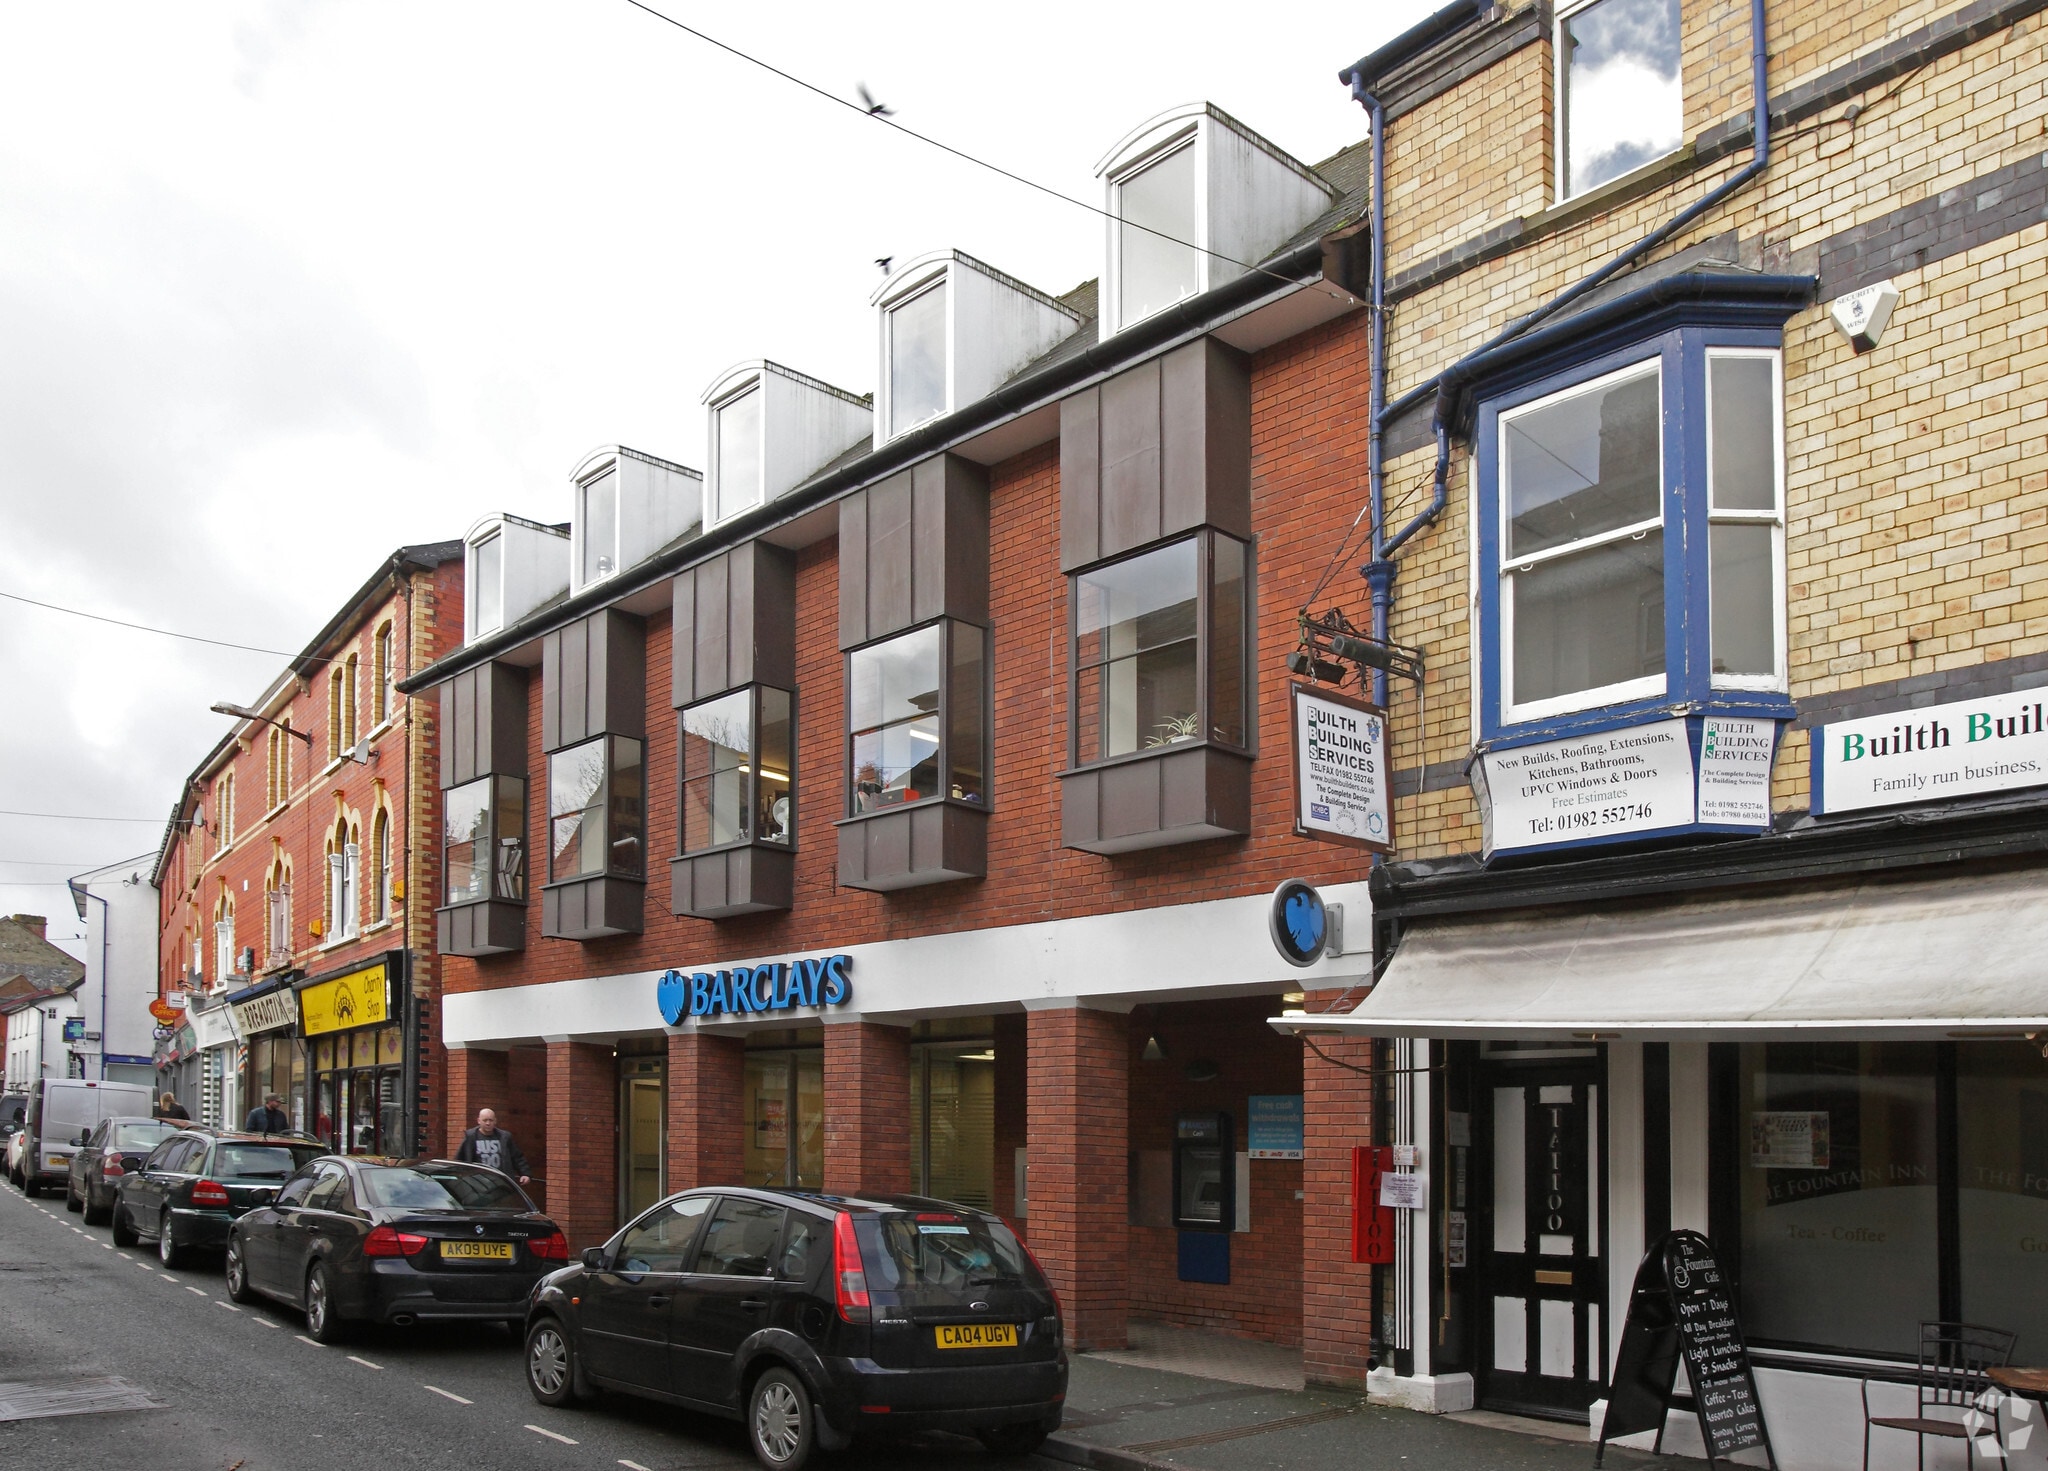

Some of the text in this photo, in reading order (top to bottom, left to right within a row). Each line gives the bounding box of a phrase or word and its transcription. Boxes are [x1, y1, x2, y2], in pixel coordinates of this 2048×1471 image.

[1837, 287, 1876, 305] SECURITY
[1308, 706, 1356, 732] BUILTH
[1707, 722, 1754, 734] BUILTH
[1308, 726, 1372, 754] BUILDING
[1706, 735, 1769, 748] BUILDING
[1841, 703, 2048, 762] Builth Buil
[1309, 744, 1374, 773] SERVICES
[1497, 731, 1674, 771] New Builds, Roofing, Extensions,
[1705, 749, 1768, 761] SERVICES
[1310, 762, 1374, 785] TEL/FAX 01982 552746
[1529, 755, 1645, 781] Kitchens, Bathrooms,
[1716, 770, 1744, 778] Complete
[1873, 760, 2041, 792] Family run business,
[1522, 768, 1658, 798] UPVC Windows & Doors
[1712, 778, 1738, 786] Building
[1316, 784, 1370, 804] The Complete Design
[1552, 789, 1628, 808] Free Estimates
[1325, 796, 1346, 810] Building
[1348, 800, 1366, 813] Service
[1704, 800, 1716, 808] Tel:
[1529, 802, 1652, 834] Tel: 01982 552746
[364, 974, 382, 995] Charity
[691, 955, 852, 1016] BARCLAYS
[368, 998, 380, 1020] Shop
[1258, 1101, 1294, 1110] Free cash
[1547, 1106, 1563, 1232] TATTOO
[1787, 1166, 1881, 1196] FOUNTAIN
[1889, 1164, 1928, 1179] INN
[1787, 1224, 1816, 1239] Tea
[1832, 1226, 1886, 1243] Coffee
[447, 1243, 507, 1256] AK09 UYE
[1680, 1244, 1694, 1256] The
[1684, 1258, 1716, 1272] Fountain
[1704, 1272, 1720, 1284] Cafe
[1680, 1299, 1728, 1318] Open 7 Days
[943, 1325, 1010, 1344] CA04 UGV
[1684, 1318, 1735, 1333] All Day Breakfast
[1689, 1342, 1741, 1362] Light Lunches
[1701, 1358, 1737, 1374] & Snacks
[1701, 1381, 1712, 1389] Full
[1706, 1402, 1756, 1422] Assorted Cakes
[1712, 1422, 1758, 1439] Sunday Carvery
